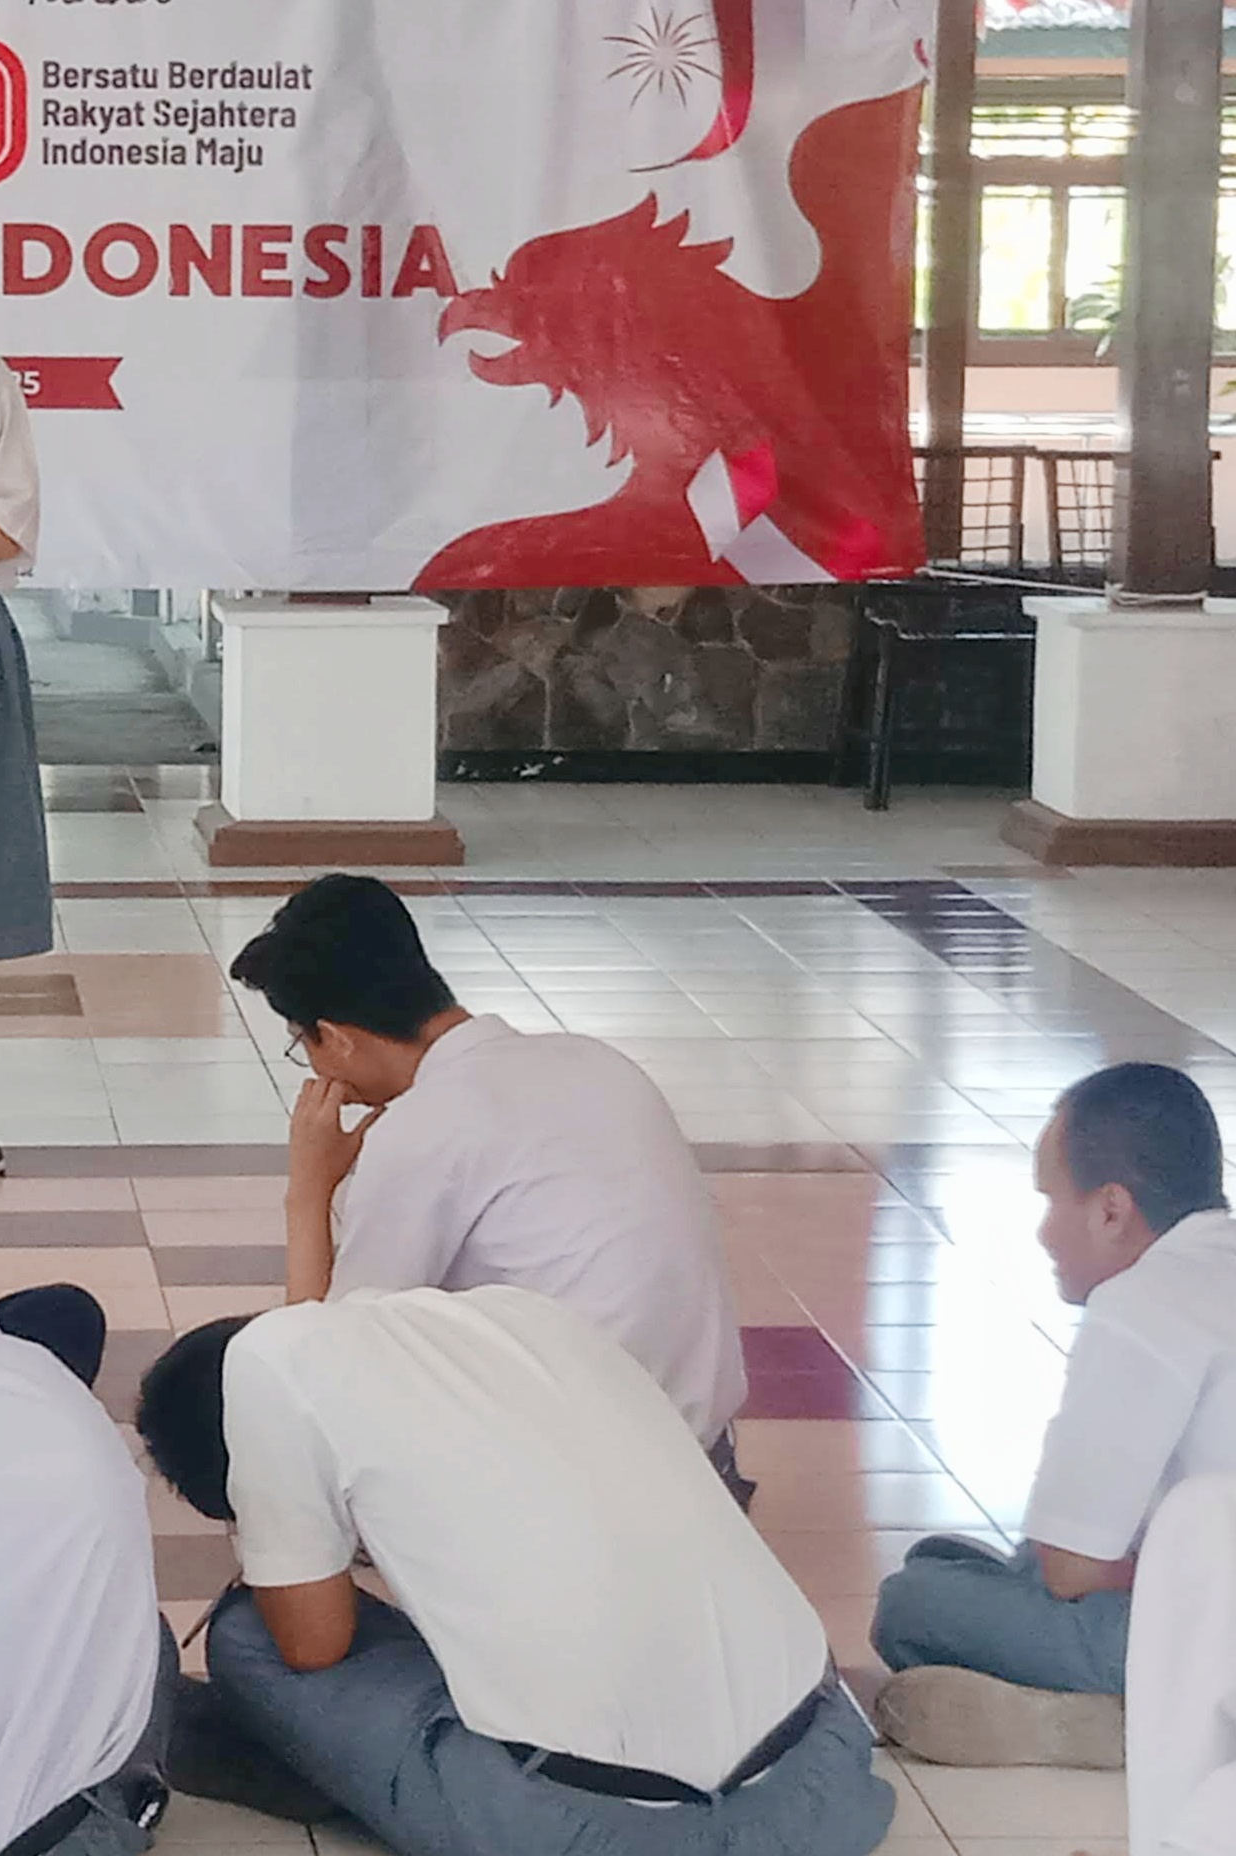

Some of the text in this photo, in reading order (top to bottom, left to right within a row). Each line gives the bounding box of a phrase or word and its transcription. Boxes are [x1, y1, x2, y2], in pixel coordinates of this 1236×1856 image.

[42, 60, 313, 90] Bersatu Berdaulat
[42, 99, 297, 135] Rakyat Sejahtera
[42, 137, 264, 174] Indonesia Maju
